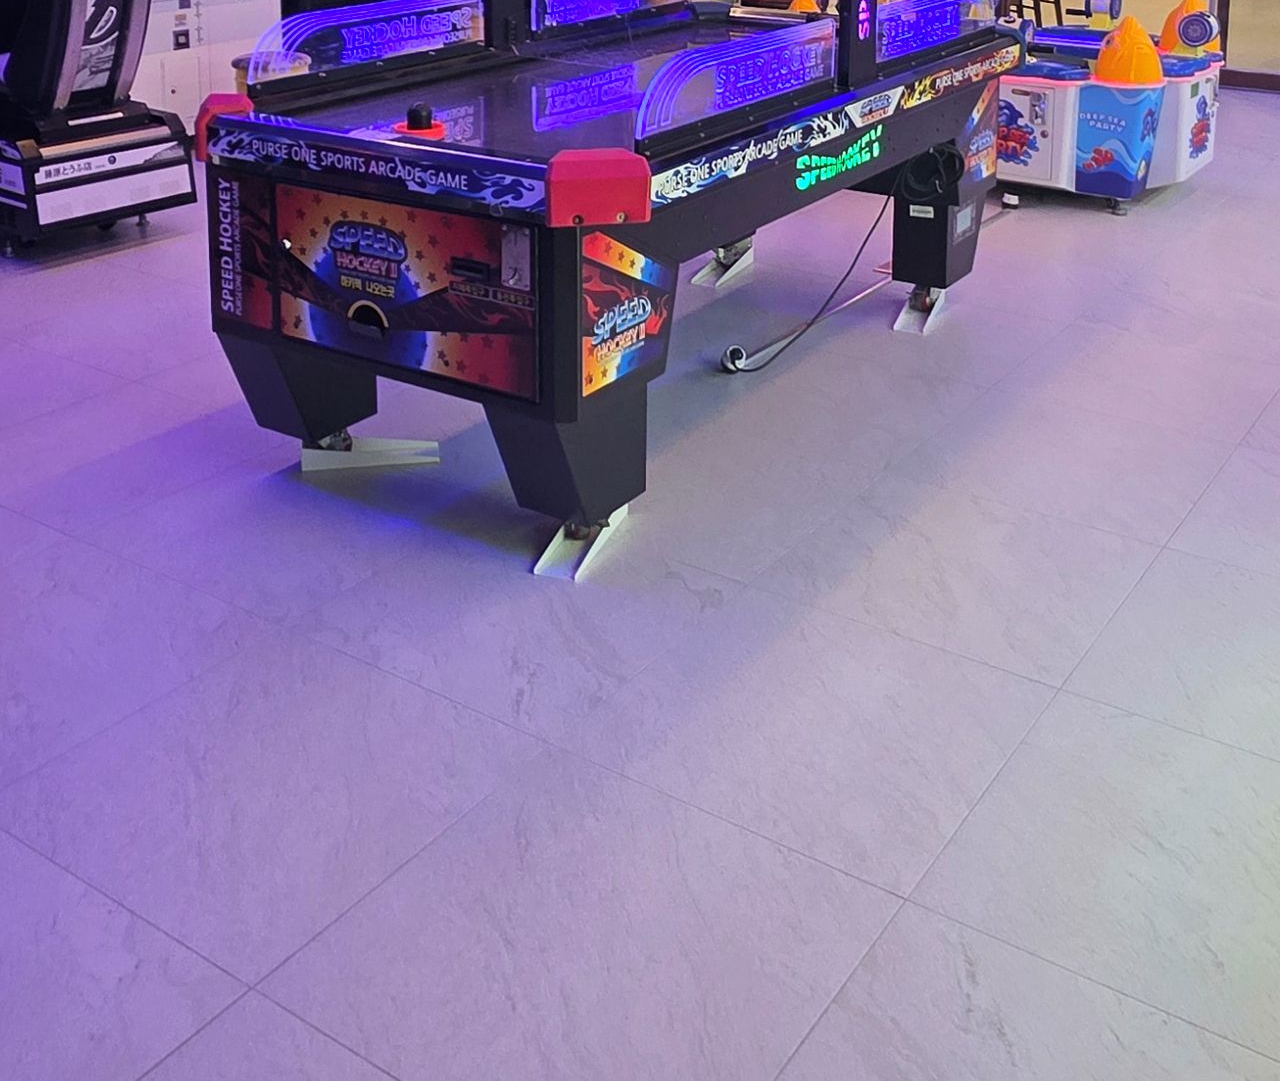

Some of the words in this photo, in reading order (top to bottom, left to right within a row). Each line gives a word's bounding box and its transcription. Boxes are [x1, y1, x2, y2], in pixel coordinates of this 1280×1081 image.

[1088, 121, 1124, 132] PARTY
[1106, 114, 1127, 127] SEA
[43, 161, 93, 180] 藤原とうふ店
[251, 138, 289, 159] PURSE
[291, 145, 317, 165] ONE
[320, 150, 366, 173] SPORTS
[368, 158, 423, 184] ARCADE
[426, 168, 469, 191] GAME
[656, 169, 688, 198] PURSE
[688, 161, 711, 183] ONE
[710, 147, 744, 176] SPORTS
[743, 136, 778, 167] ARCADE
[778, 128, 804, 151] GAME
[217, 177, 234, 252] HOCKEY
[330, 224, 406, 261] SPEED
[336, 251, 389, 276] HOCKEY
[220, 256, 235, 313] SPEED
[592, 295, 653, 346] SPEED
[593, 329, 639, 365] HOCKEY
